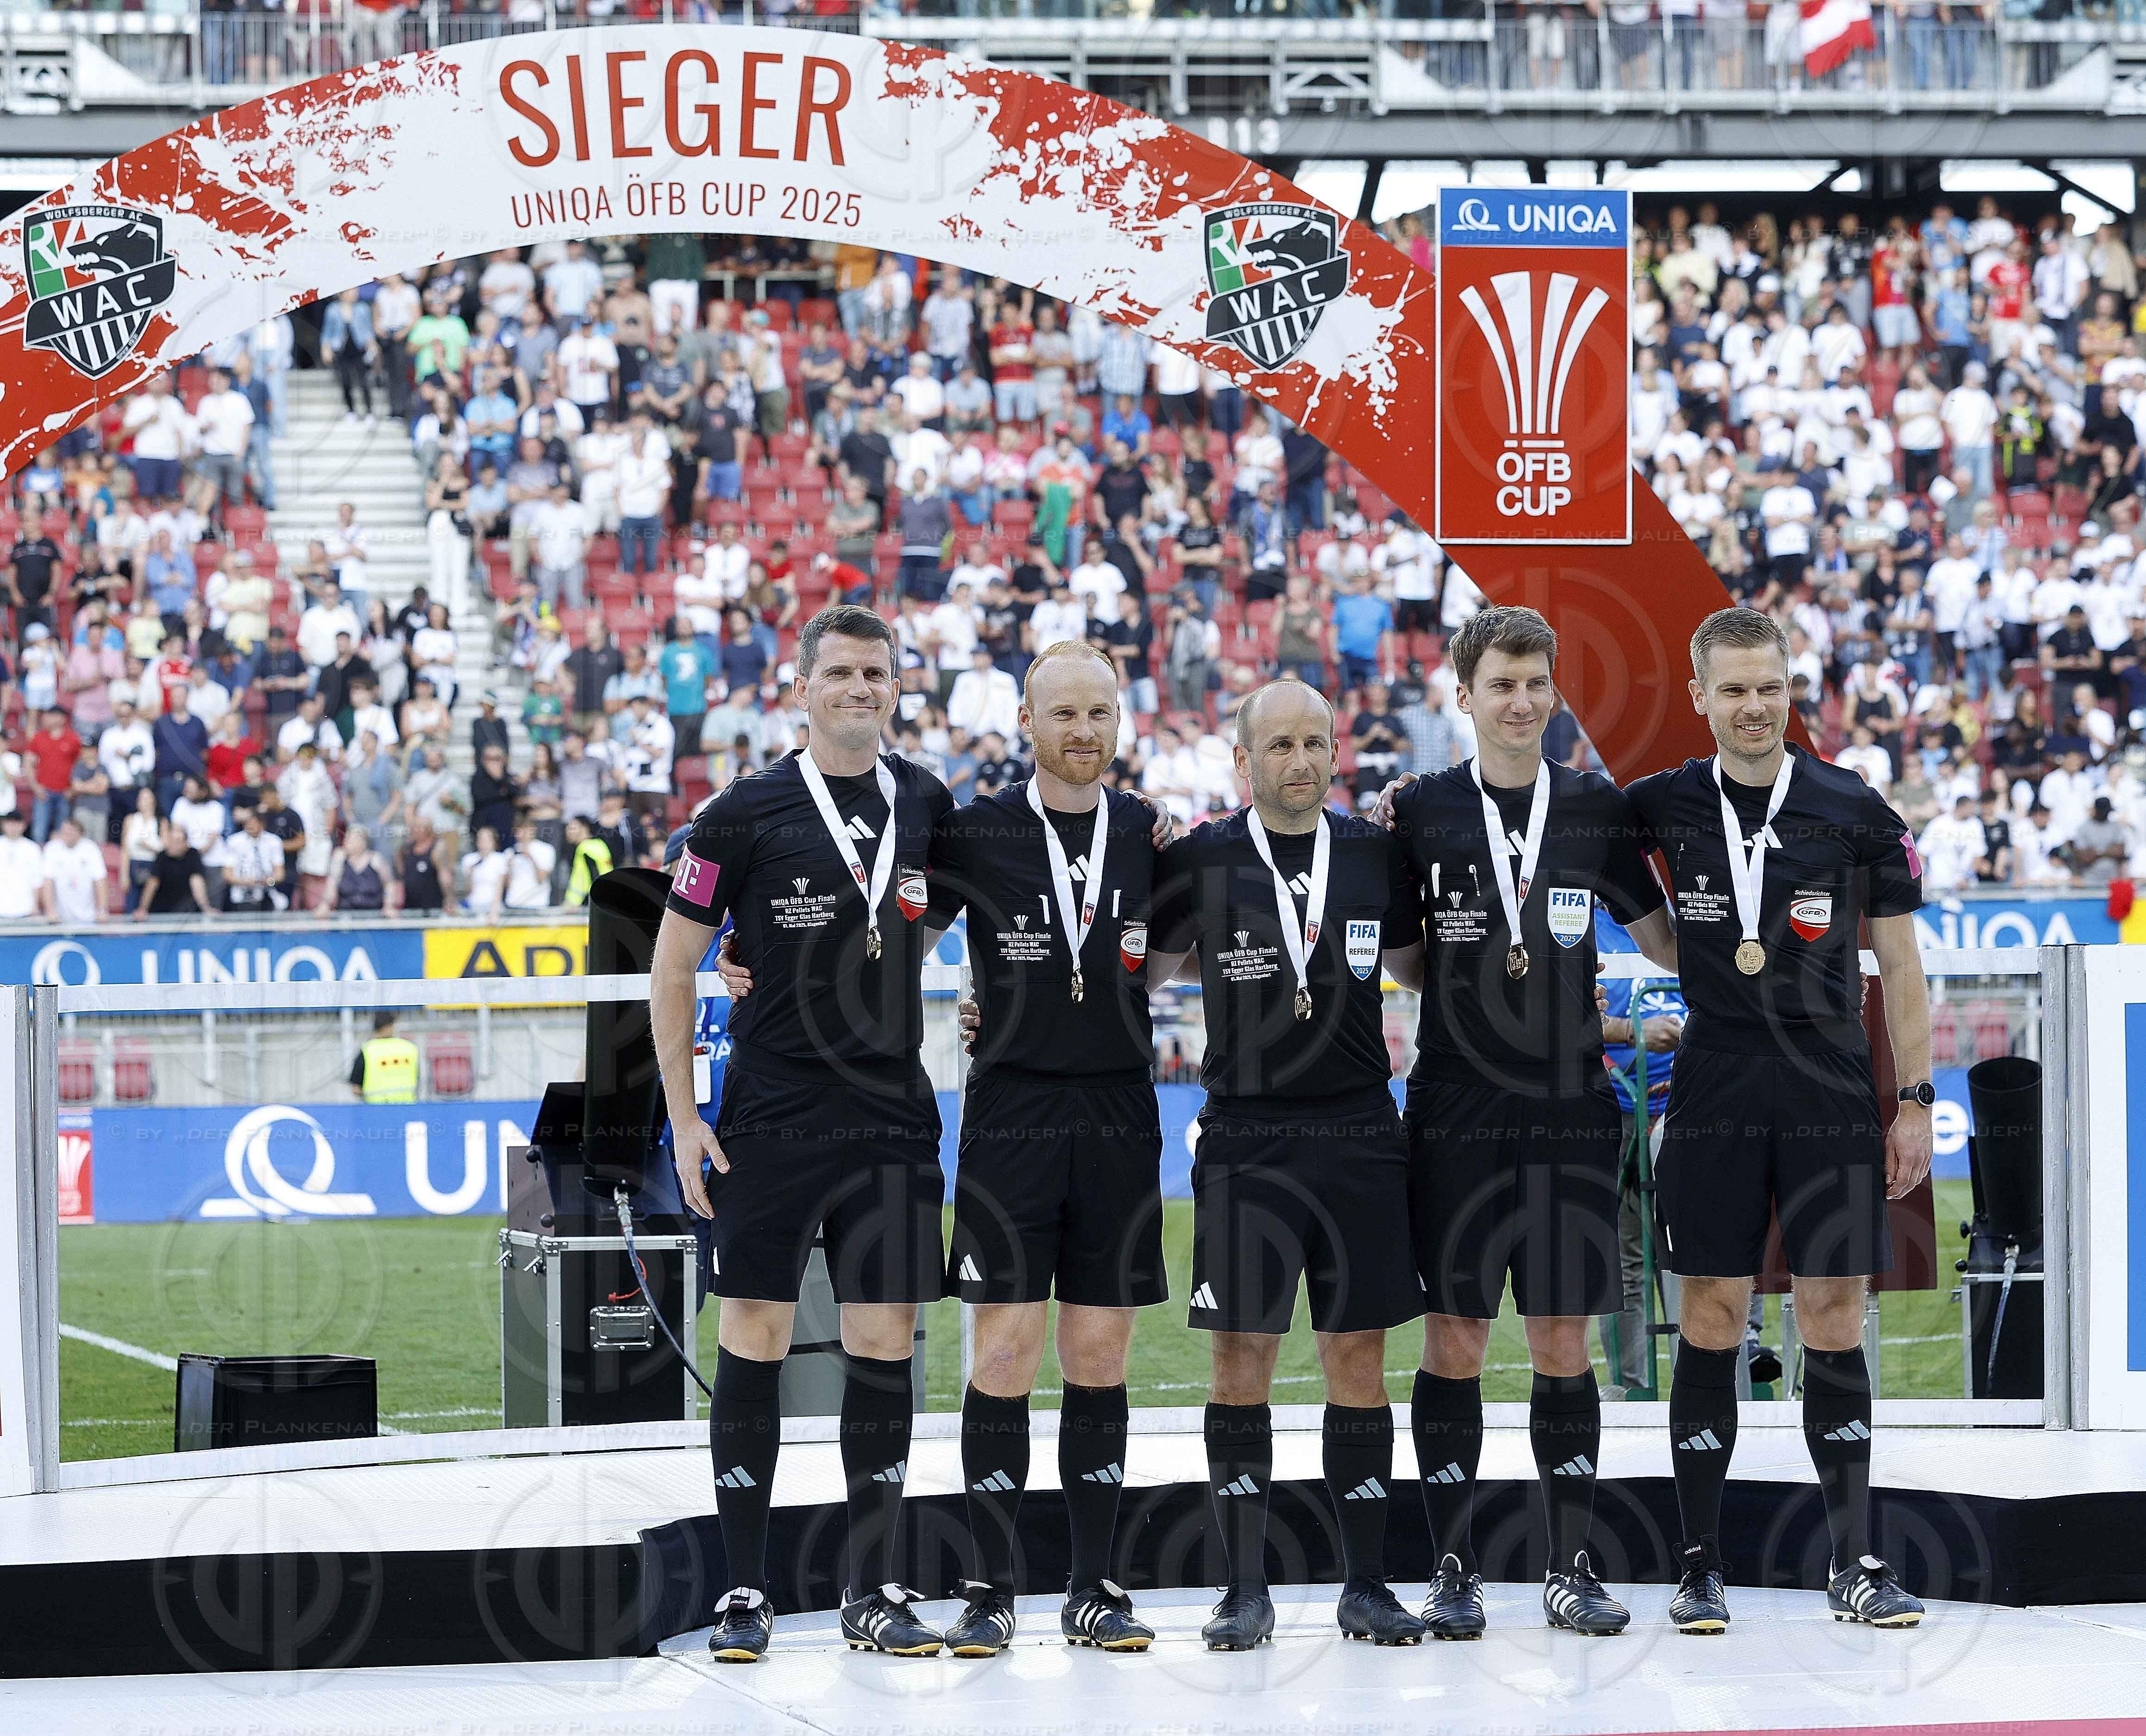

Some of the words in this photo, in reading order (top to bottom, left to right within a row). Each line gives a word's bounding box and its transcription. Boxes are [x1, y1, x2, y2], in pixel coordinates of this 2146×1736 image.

[499, 50, 852, 166] SIEGER
[44, 207, 124, 221] WOLFSBERGER
[128, 212, 143, 222] AC
[511, 185, 612, 228] UNIQA
[627, 174, 686, 217] ÖFB
[702, 183, 766, 217] CUP
[782, 186, 862, 227] 2025
[1224, 205, 1300, 218] WOLFSBERGER
[1303, 208, 1318, 220] AC
[1508, 204, 1617, 233] UNIQA
[49, 273, 153, 329] WAC
[1227, 270, 1326, 324] WAC
[1496, 485, 1572, 517] CUP
[678, 854, 702, 895] T
[1553, 892, 1586, 907] FIFA
[1350, 924, 1376, 938] FIFA
[1913, 911, 2078, 949] NIQA
[1217, 951, 1234, 960] UNIQA
[1234, 949, 1245, 957] ÖFB
[1258, 946, 1278, 955] Finale
